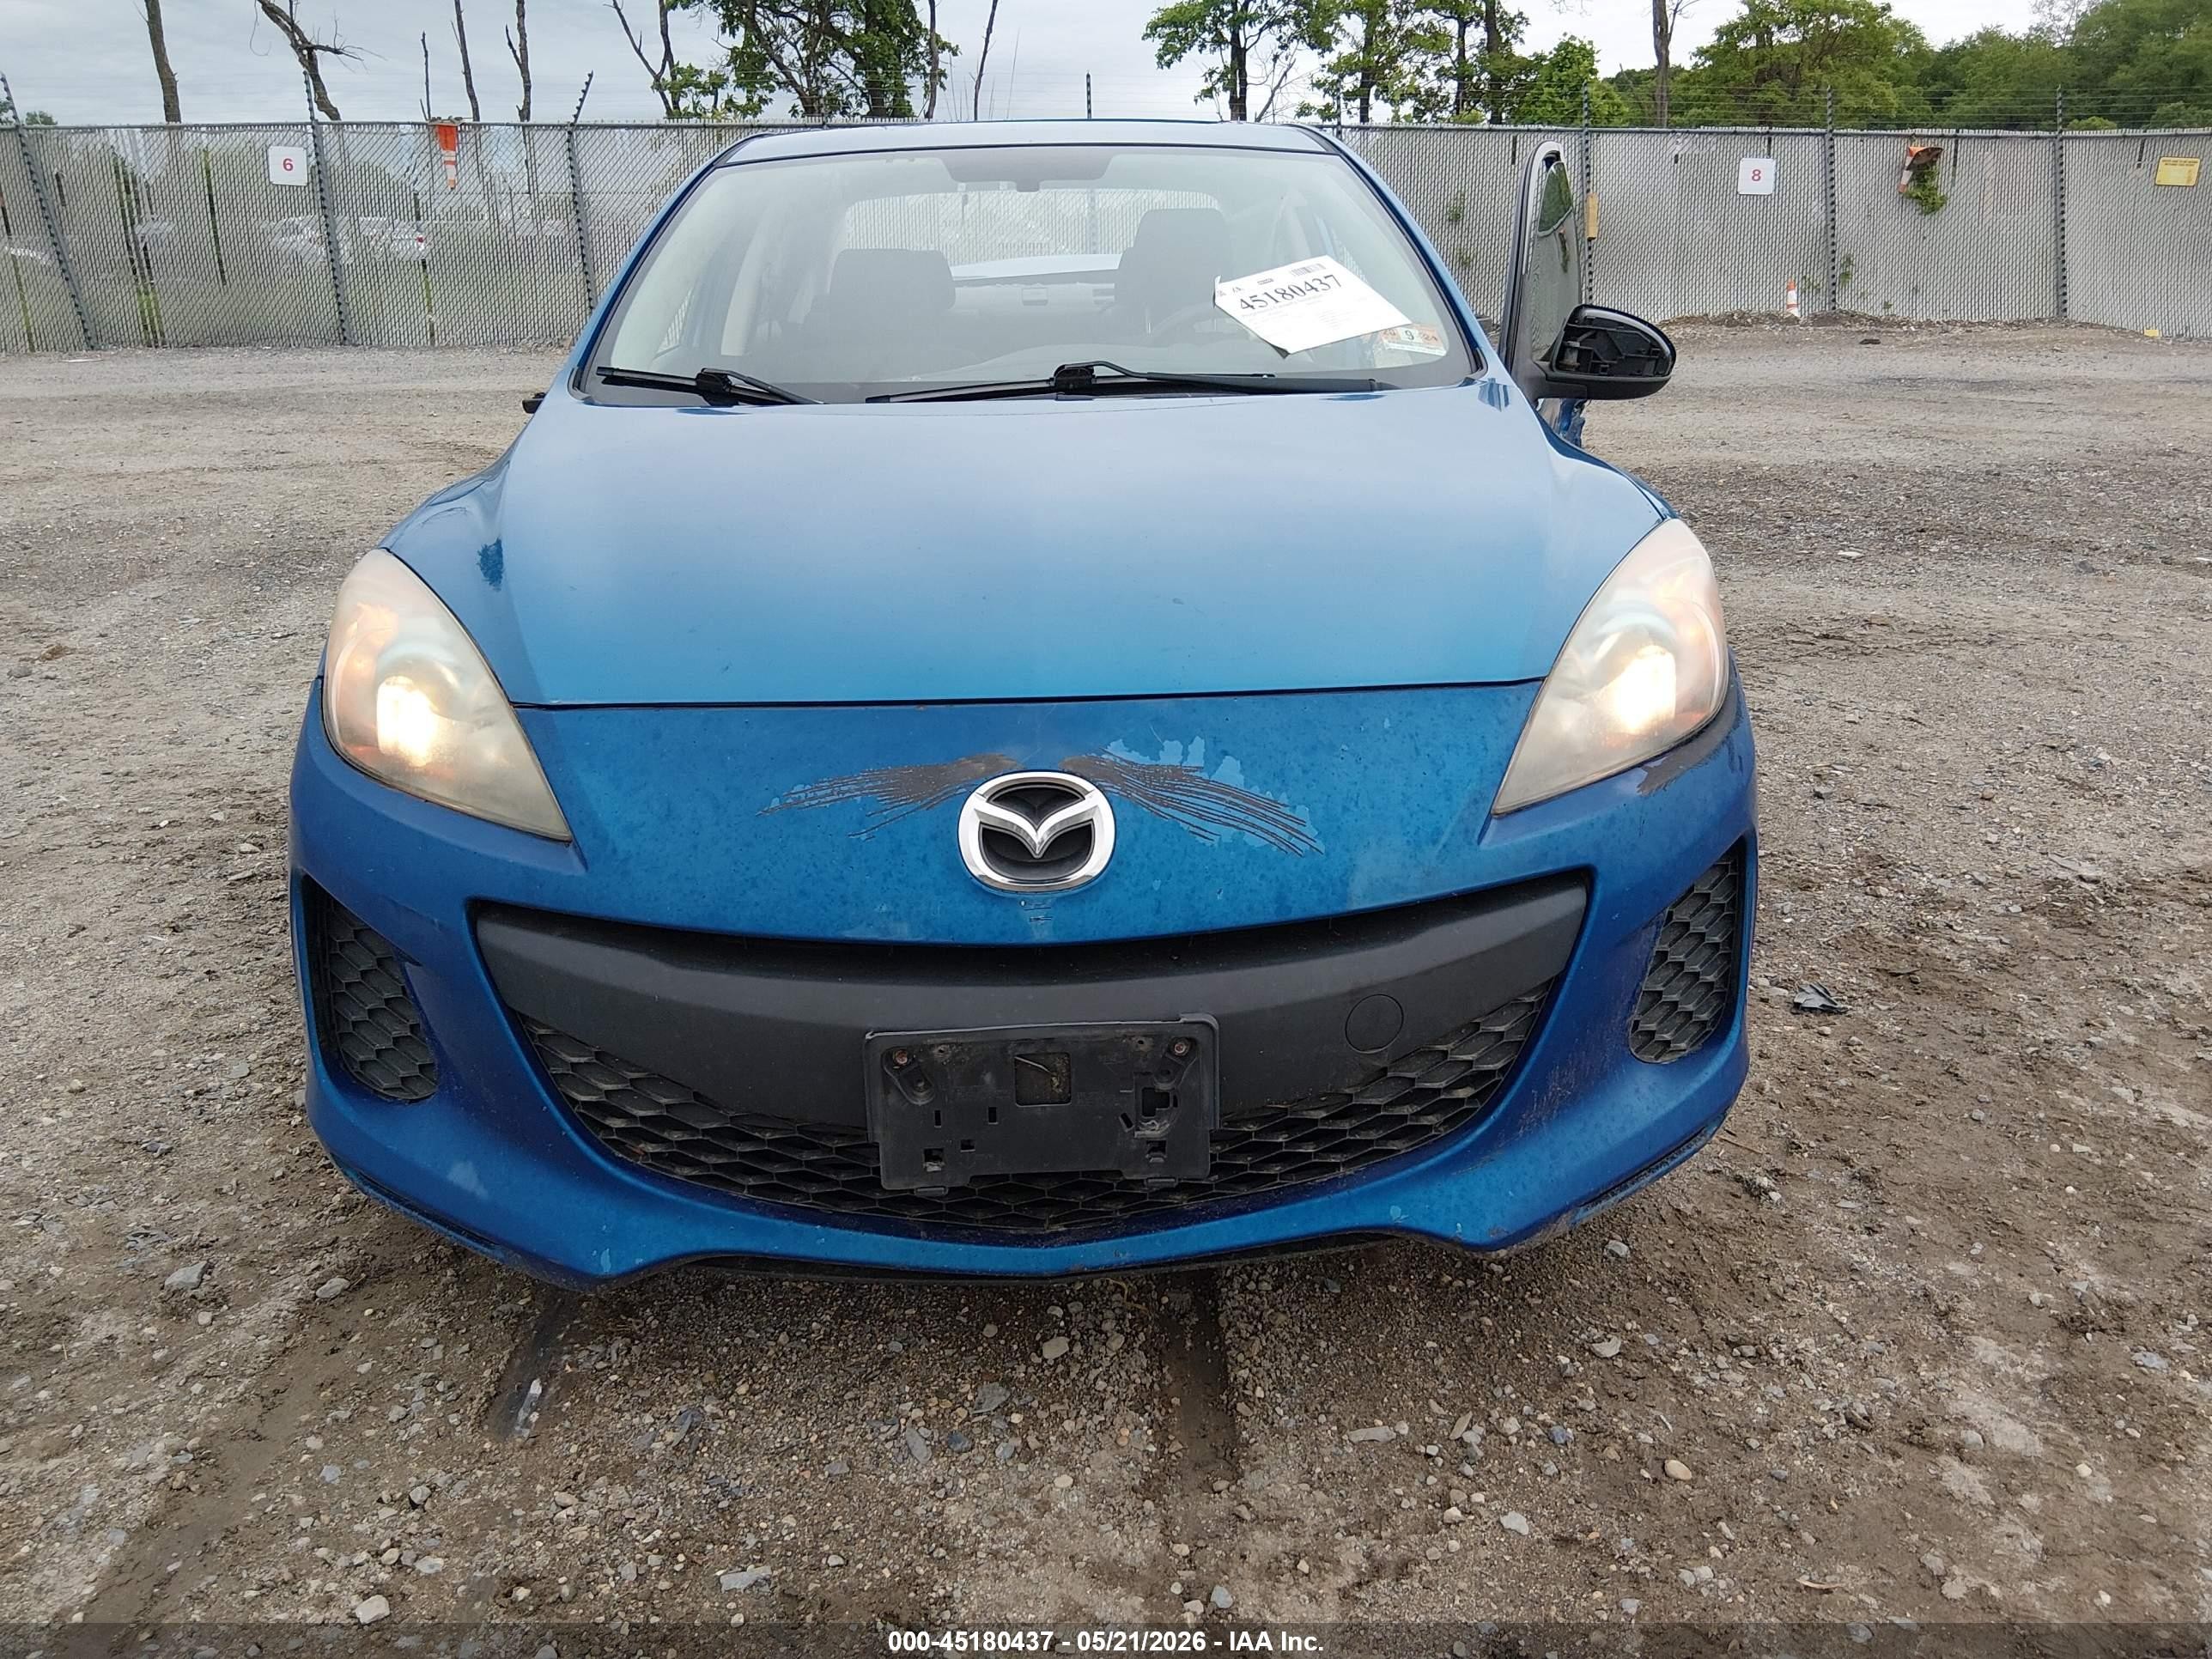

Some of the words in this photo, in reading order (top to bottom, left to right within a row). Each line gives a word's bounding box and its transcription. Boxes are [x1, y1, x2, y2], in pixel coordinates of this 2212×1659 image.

[283, 158, 294, 172] 6
[1751, 168, 1761, 182] 8
[1239, 274, 1342, 310] 45180437
[1404, 329, 1415, 341] 9
